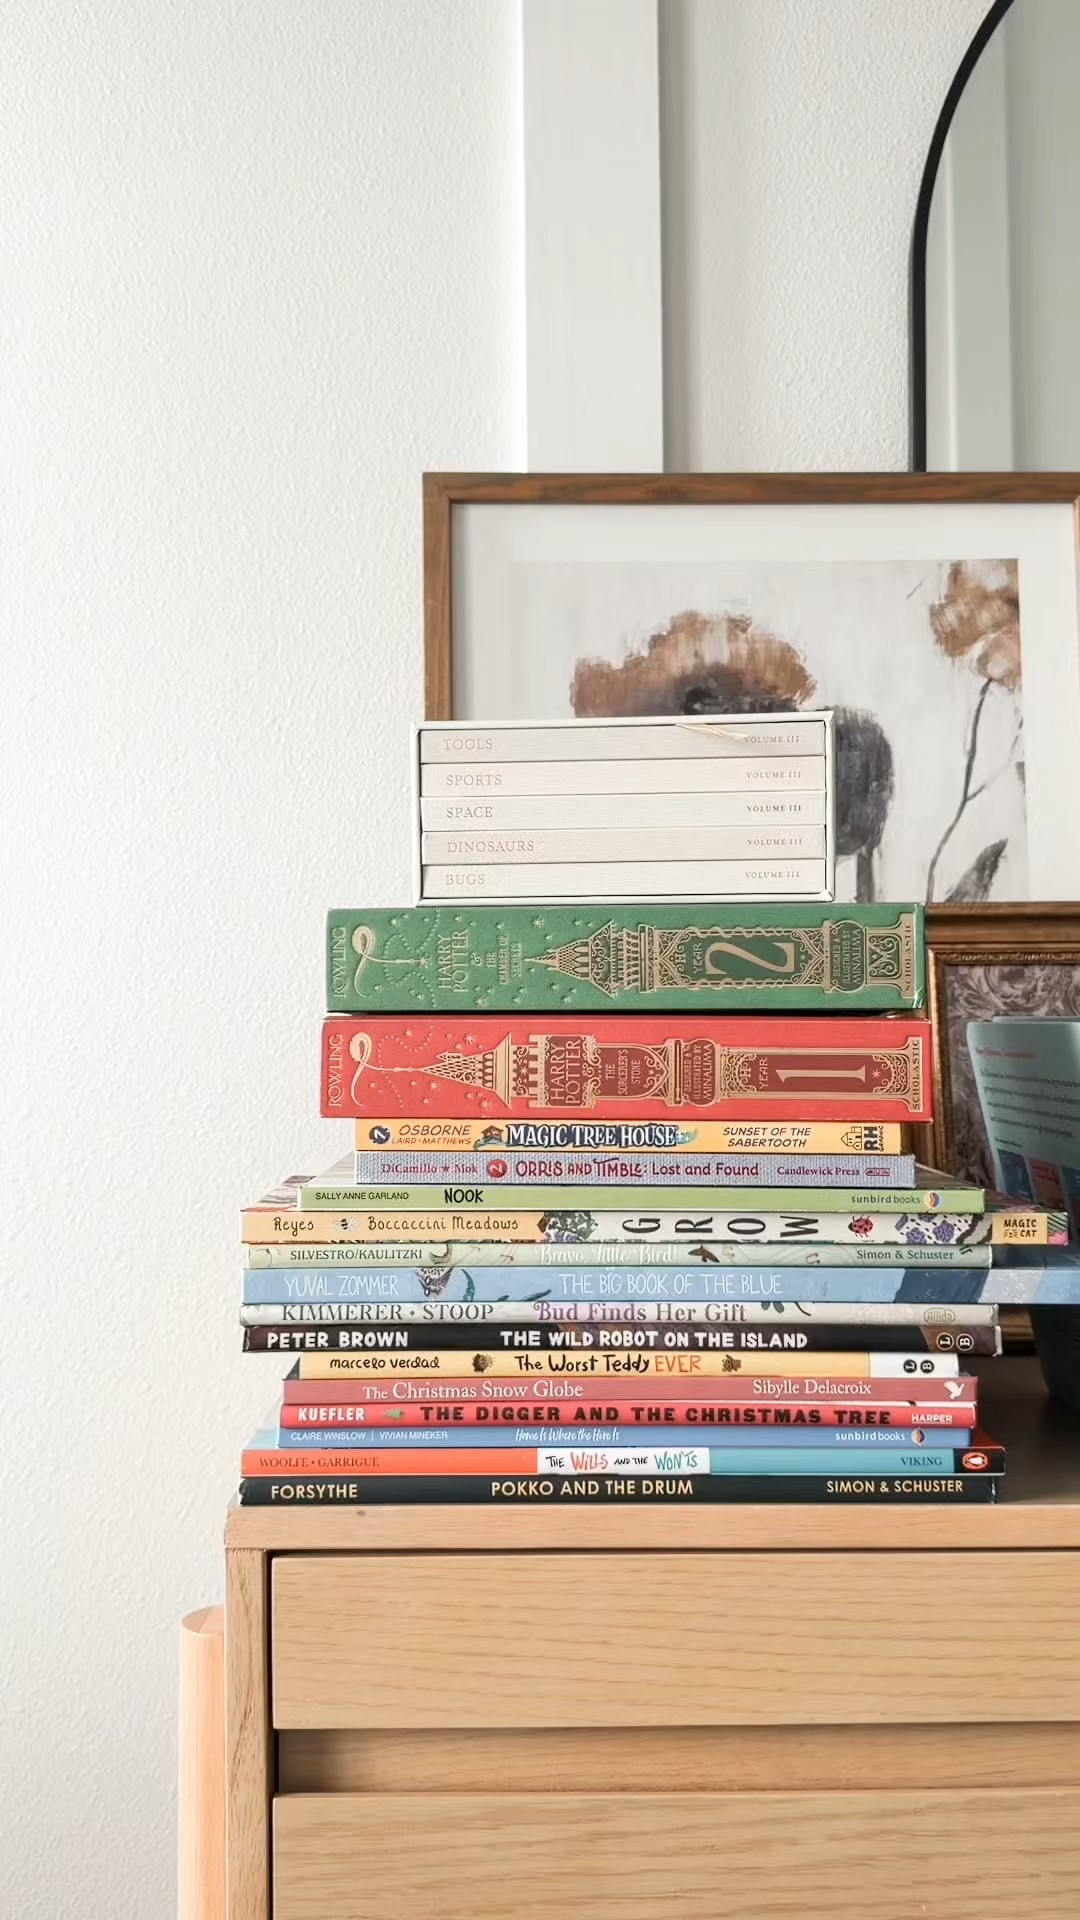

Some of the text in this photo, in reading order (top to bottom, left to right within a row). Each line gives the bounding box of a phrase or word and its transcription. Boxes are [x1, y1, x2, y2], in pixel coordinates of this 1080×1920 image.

[442, 738, 494, 751] TOOLS
[744, 734, 800, 744] VOLUME III
[445, 774, 503, 787] SPORTS
[746, 770, 802, 780] VOLUME III
[446, 806, 494, 819] SPACE
[747, 803, 802, 813] VOLUME III
[447, 839, 535, 853] DINOSAURS
[747, 837, 802, 847] VOLUME III
[446, 873, 486, 886] BUGS
[745, 870, 800, 879] VOLUME III
[331, 927, 346, 998] ROWLING
[438, 934, 452, 989] HARRY
[452, 929, 468, 993] POTTER
[471, 953, 481, 966] &
[485, 952, 496, 968] THE
[693, 943, 703, 973] YEAR
[705, 942, 795, 975] 2
[842, 941, 850, 984] ILLUSTRATED
[851, 928, 861, 985] MINALIMA
[903, 923, 912, 991] SCHOLASTIC
[328, 1035, 343, 1107] ROWLING
[550, 1042, 565, 1100] HARRY
[565, 1039, 581, 1104] POTTER
[582, 1062, 595, 1077] &
[605, 1064, 615, 1080] THE
[618, 1049, 628, 1095] SORCERER'S
[631, 1060, 641, 1084] STONE
[683, 1060, 692, 1092] DESIGNED
[692, 1056, 702, 1100] ILLUSTRATED
[703, 1044, 712, 1100] MINALIMA
[759, 1057, 769, 1089] YEAR
[775, 1063, 866, 1084] 1
[912, 1039, 921, 1110] SCHOLASTIC
[398, 1125, 472, 1136] OSBORNE
[507, 1124, 677, 1148] MAGIC TREE HOUSE
[723, 1127, 811, 1136] SUNSET OF THE
[864, 1126, 878, 1151] RH
[391, 1136, 472, 1145] LAIRD MATTHEWS
[728, 1138, 807, 1148] SABERTOOTH
[381, 1163, 478, 1174] DiCamillo Mok
[515, 1160, 563, 1177] ORRIS
[568, 1162, 592, 1175] AND
[652, 1161, 681, 1176] Lost
[685, 1161, 711, 1176] and
[716, 1162, 759, 1176] Found
[777, 1166, 860, 1176] Candlewick Press
[315, 1192, 409, 1200] SALLY ANNE GARLAND
[444, 1187, 484, 1203] NOOK
[851, 1194, 921, 1204] sunbird books
[274, 1216, 314, 1237] Reyes
[367, 1215, 519, 1230] Boccaccini Meadows
[622, 1215, 819, 1238] GROW
[1003, 1218, 1037, 1229] MAGIC
[1019, 1229, 1038, 1239] CAT
[290, 1249, 423, 1261] SILVESTRO/KAULITZKI
[541, 1243, 586, 1265] Brave
[636, 1243, 677, 1265] Bird!
[857, 1249, 954, 1260] Simon & Schuster
[284, 1275, 398, 1297] YUVAL ZOMMER
[558, 1274, 784, 1295] THE BIG BOOK OF THE BLUE
[282, 1304, 495, 1321] KIMMERER STOOP
[533, 1301, 747, 1322] Bud Finds Her Gift
[267, 1331, 409, 1349] PETER BROWN
[501, 1331, 808, 1349] THE WILD ROBOT ON THE ISLAND
[330, 1355, 440, 1369] marcelo verdad
[514, 1353, 701, 1373] The Worst Teddy EVER
[362, 1380, 584, 1400] The Christmas Snow Globe
[753, 1378, 871, 1399] Sibylle Delacroix
[298, 1407, 365, 1422] KUEFLER
[420, 1406, 891, 1425] THE DIGGER AND THE CHRISTMAS TREE
[911, 1413, 953, 1424] HARPER
[291, 1431, 366, 1441] CLAIRE WINSLOW
[379, 1430, 448, 1440] VIVIAN MINEKER
[835, 1431, 906, 1441] sunbird books
[259, 1457, 379, 1469] WOOLFE GARRIGUE
[546, 1455, 565, 1469] THE
[614, 1457, 631, 1466] AND
[632, 1457, 648, 1465] THE
[654, 1451, 699, 1471] WON'TS
[900, 1456, 943, 1467] VIKING
[271, 1483, 358, 1500] FORSYTHE
[491, 1480, 694, 1497] POKKO AND THE DRUM
[826, 1479, 963, 1494] SIMON & SCHUSTER
